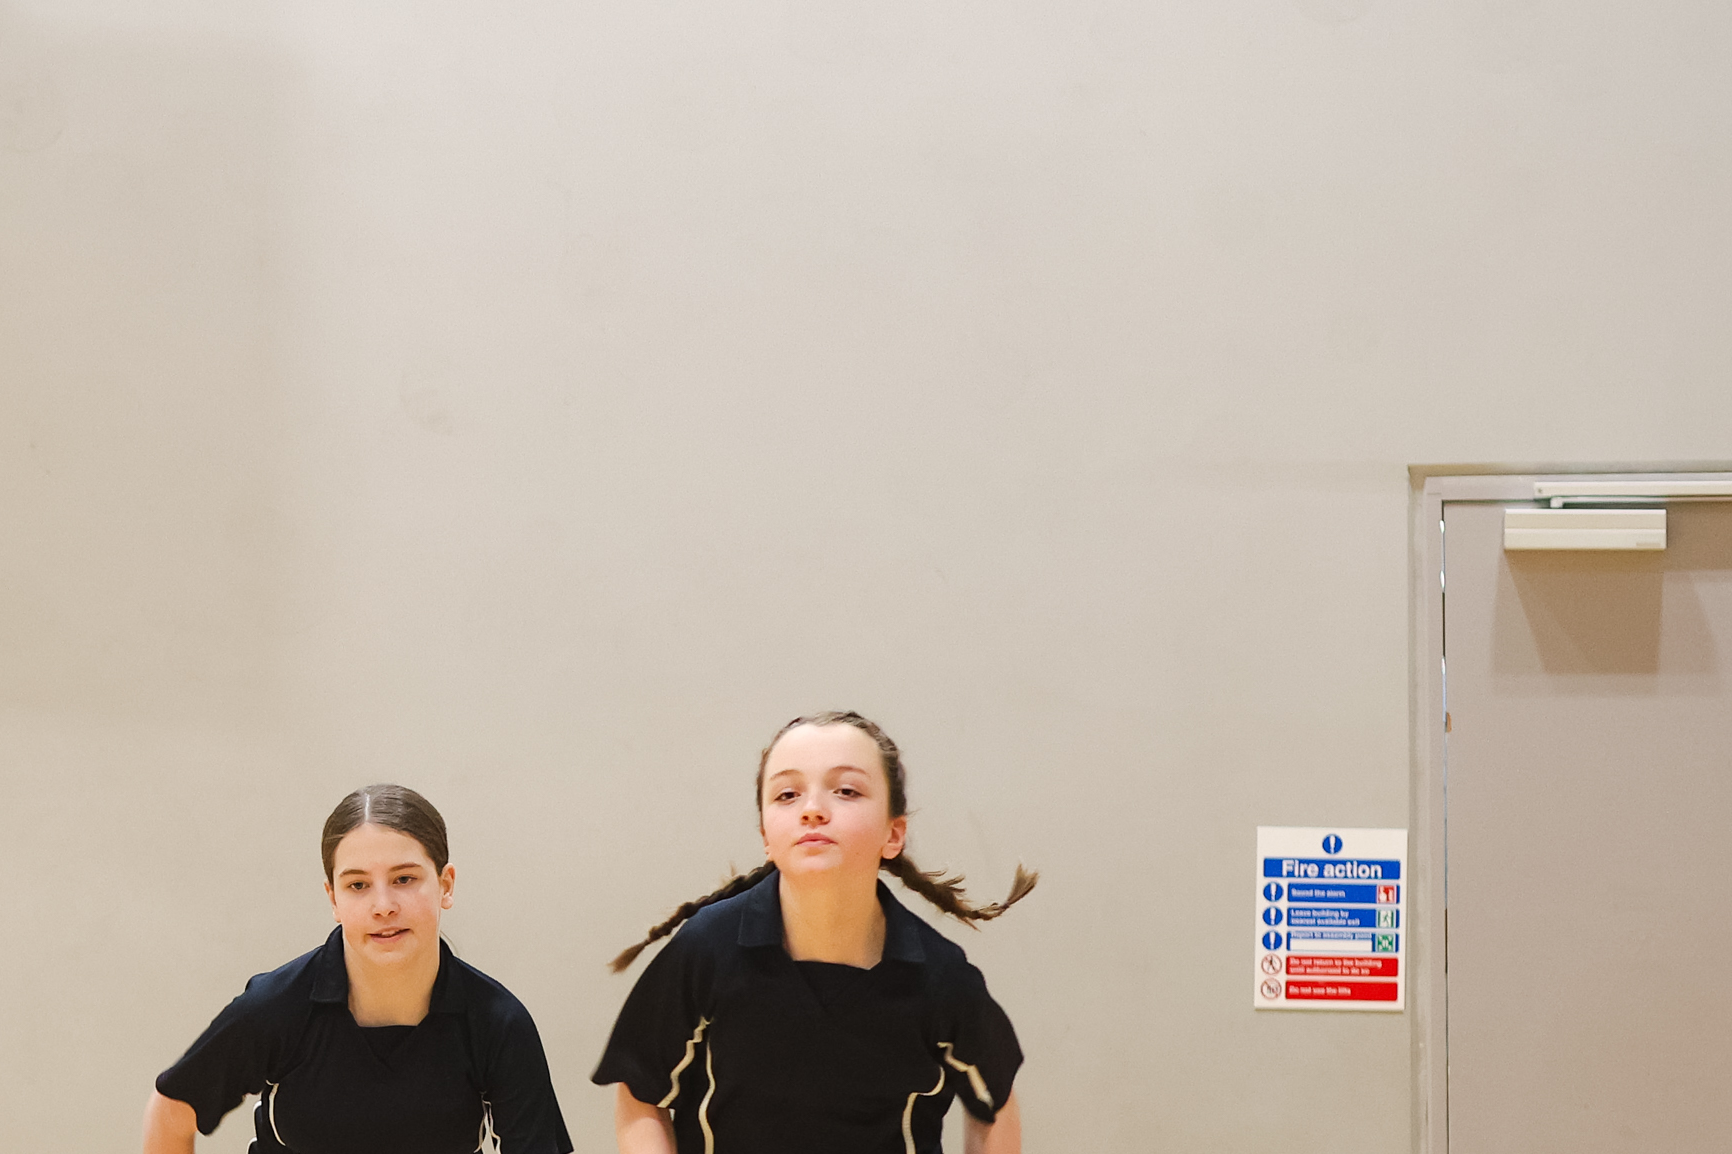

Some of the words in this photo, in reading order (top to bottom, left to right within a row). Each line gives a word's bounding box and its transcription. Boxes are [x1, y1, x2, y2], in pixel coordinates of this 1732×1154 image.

[1282, 859, 1319, 878] Fire
[1323, 860, 1382, 879] action
[1314, 888, 1325, 897] the
[1312, 909, 1339, 919] building
